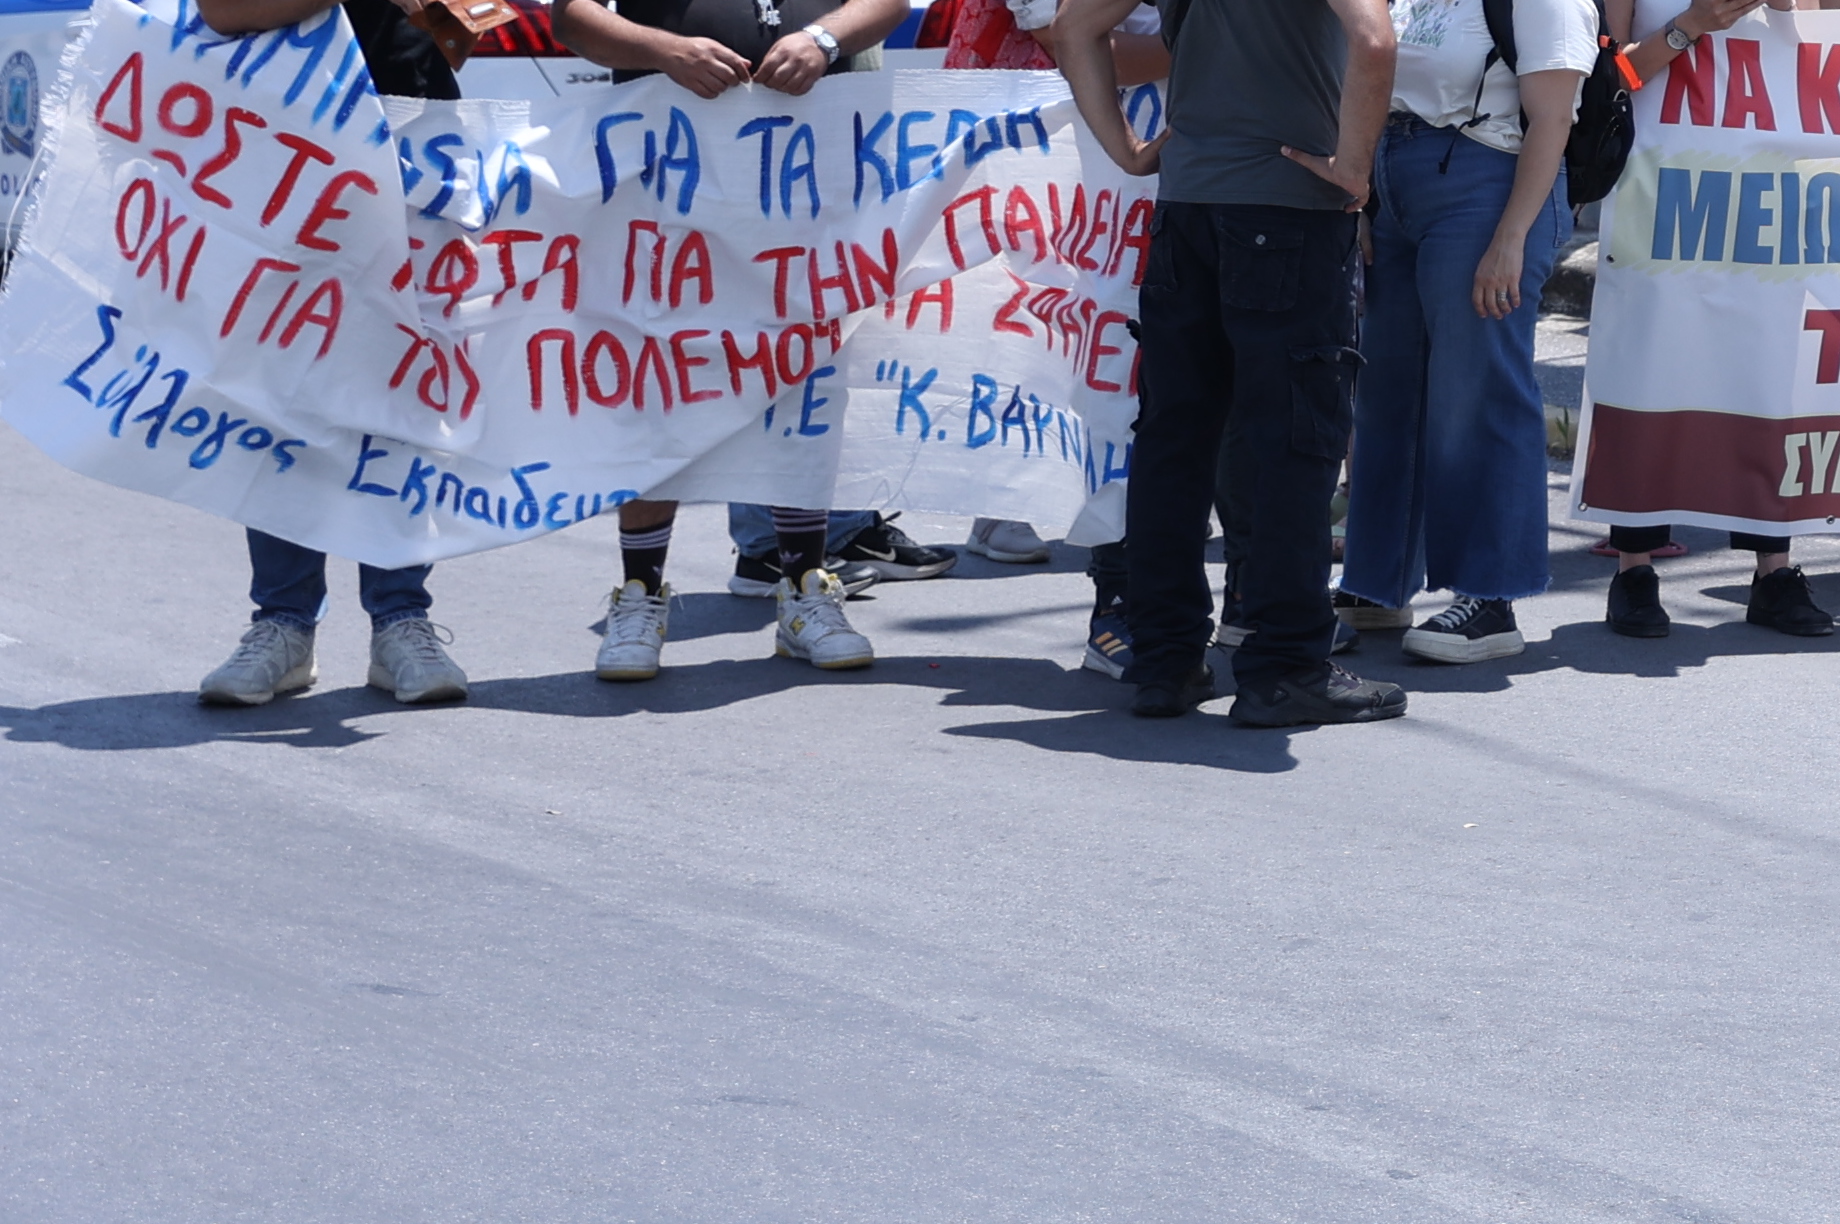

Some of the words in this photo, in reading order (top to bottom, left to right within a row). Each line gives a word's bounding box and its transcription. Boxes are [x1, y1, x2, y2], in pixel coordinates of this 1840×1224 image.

[1660, 33, 1777, 132] ΝΑ
[594, 107, 700, 216] ΓΙΑ
[737, 115, 820, 220] ΤΑ
[114, 178, 207, 303] ΟΧΙ
[219, 257, 346, 361] ΓΙΑ
[751, 228, 899, 320] ΤΗΝ
